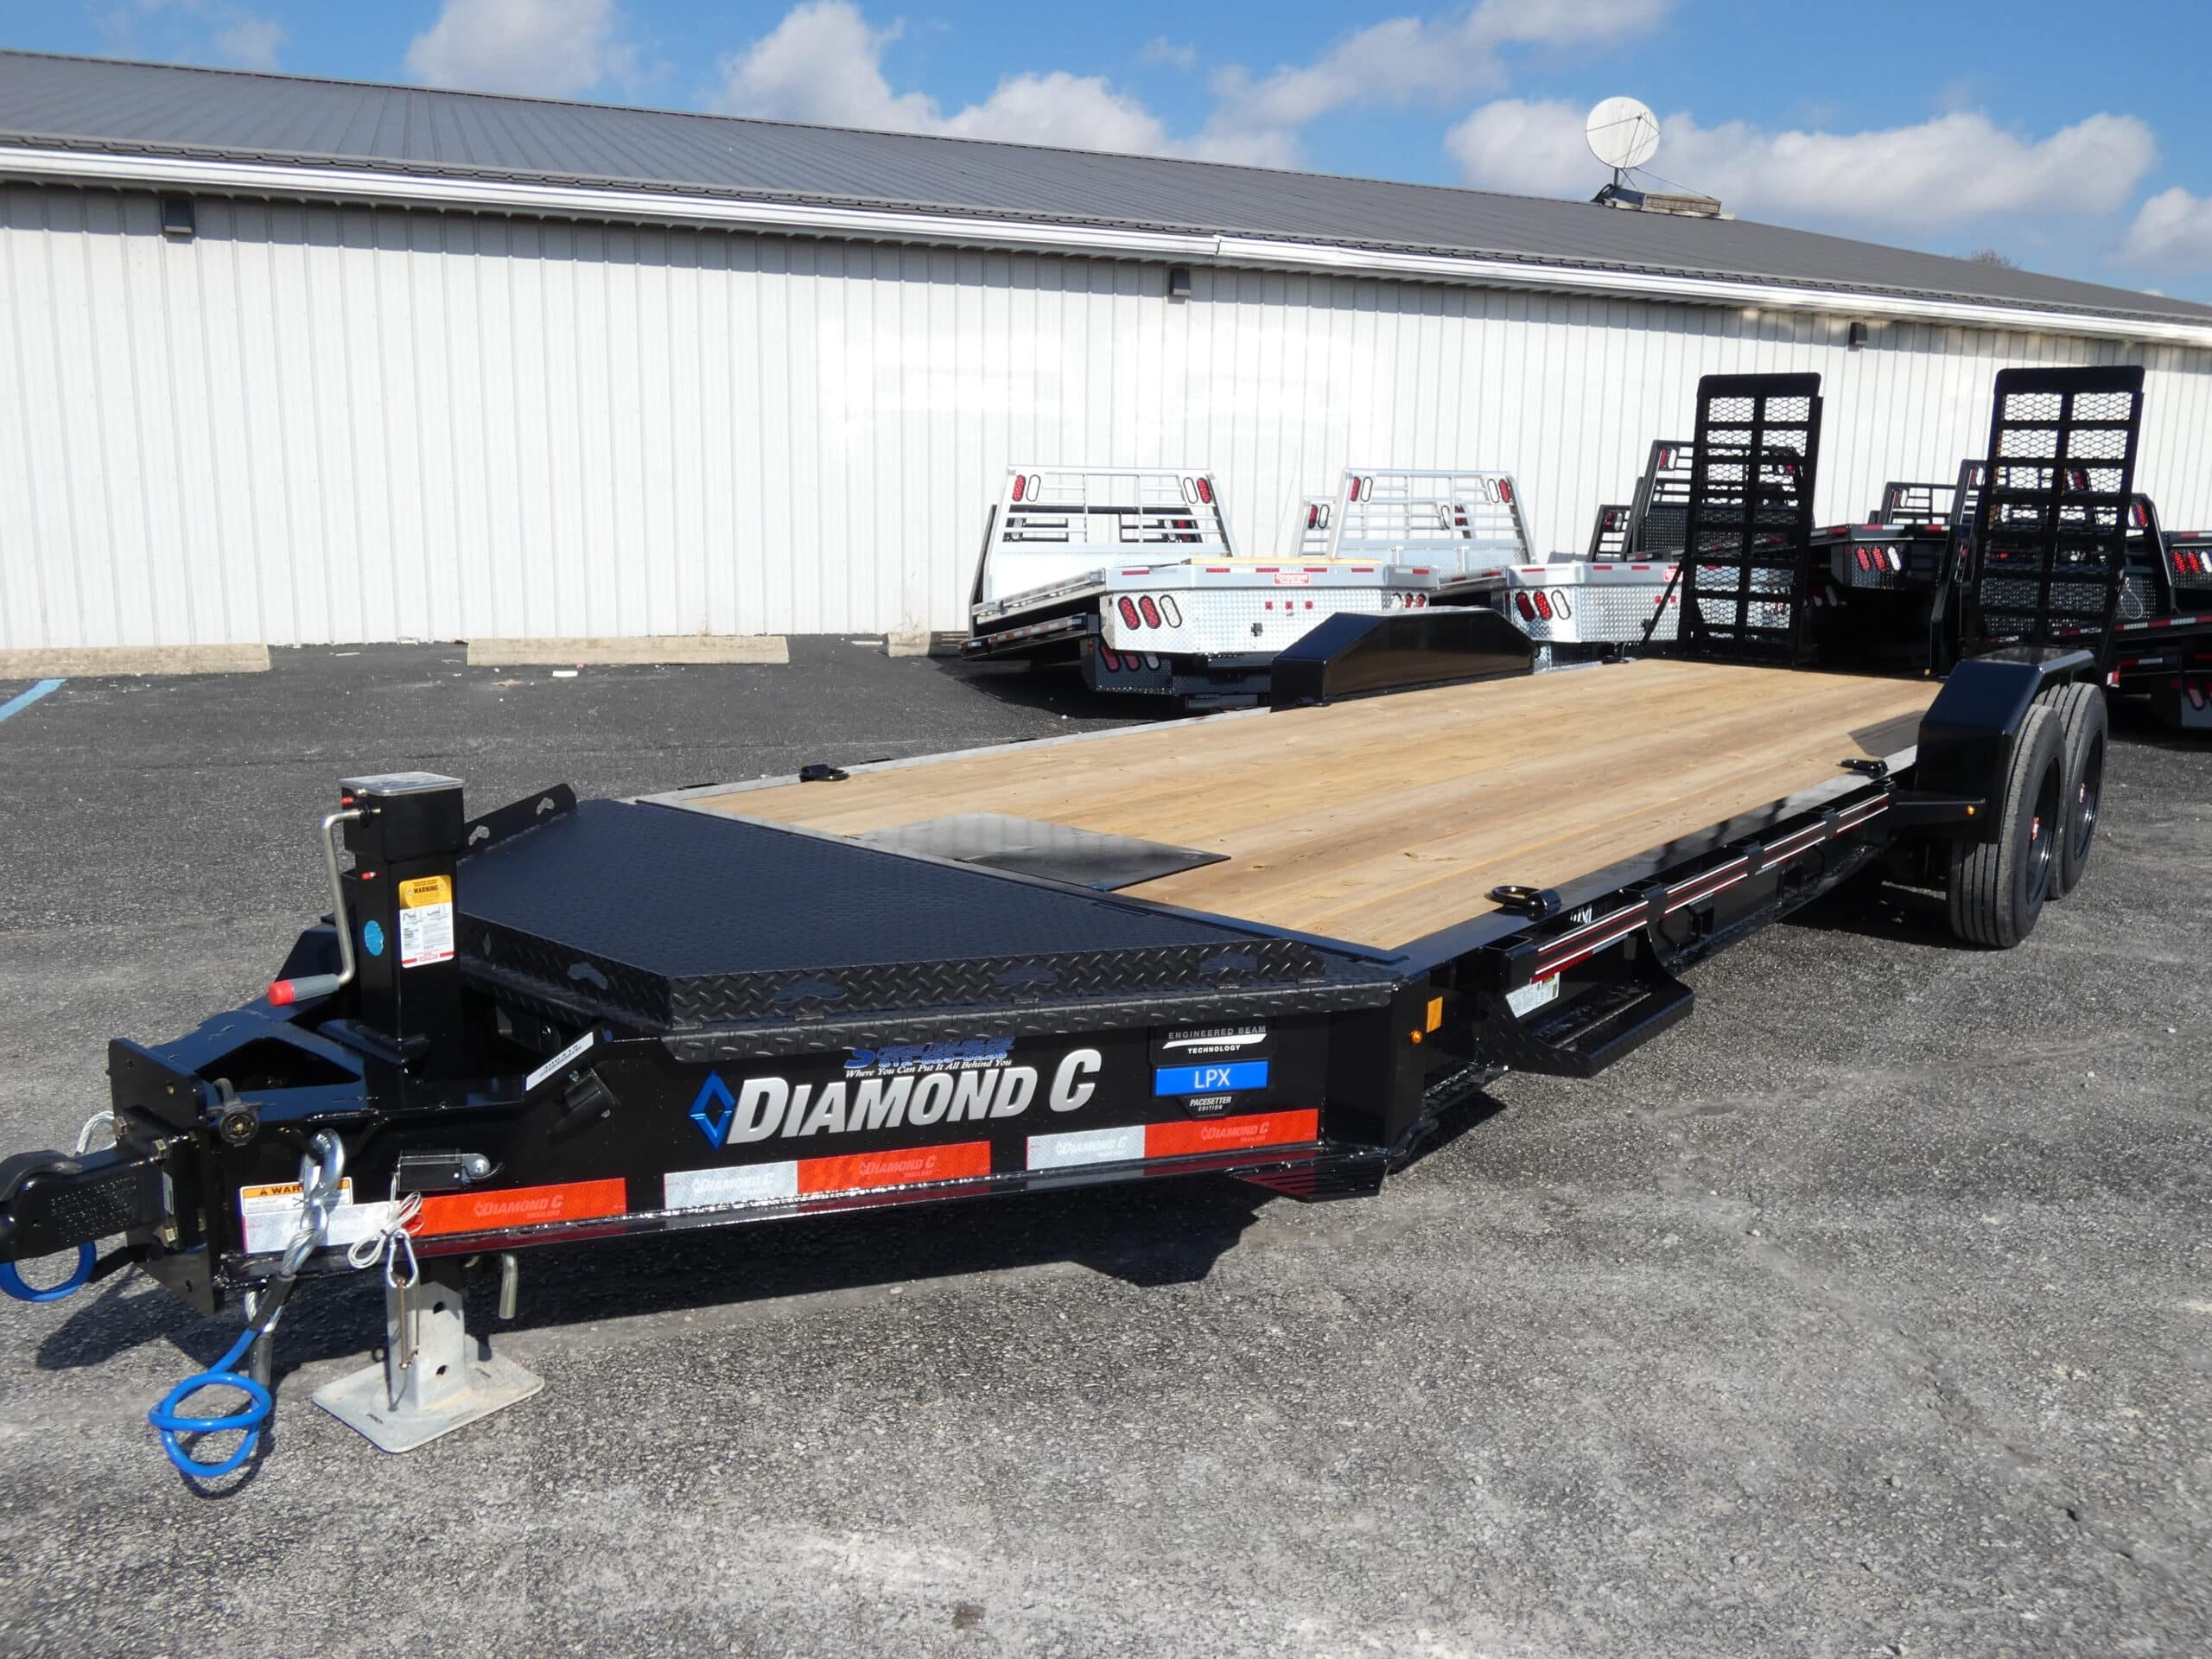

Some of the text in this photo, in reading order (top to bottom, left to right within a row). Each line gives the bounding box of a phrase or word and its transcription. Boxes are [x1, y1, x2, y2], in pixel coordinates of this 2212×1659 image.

[414, 884, 438, 893] WARNING
[1168, 1026, 1266, 1039] ENGINEERED BEAM
[1187, 1045, 1241, 1054] TECHNOLOGY
[845, 1058, 1013, 1078] Where You Can Put It All Behind You
[1194, 1068, 1230, 1089] LPX
[726, 1048, 1103, 1145] DIAMOND C
[1190, 1096, 1232, 1107] PACESETTER
[1210, 1122, 1270, 1140] DIAMOND C
[867, 1154, 938, 1174] DIAMOND C
[481, 1194, 564, 1216] DIAMOND C
